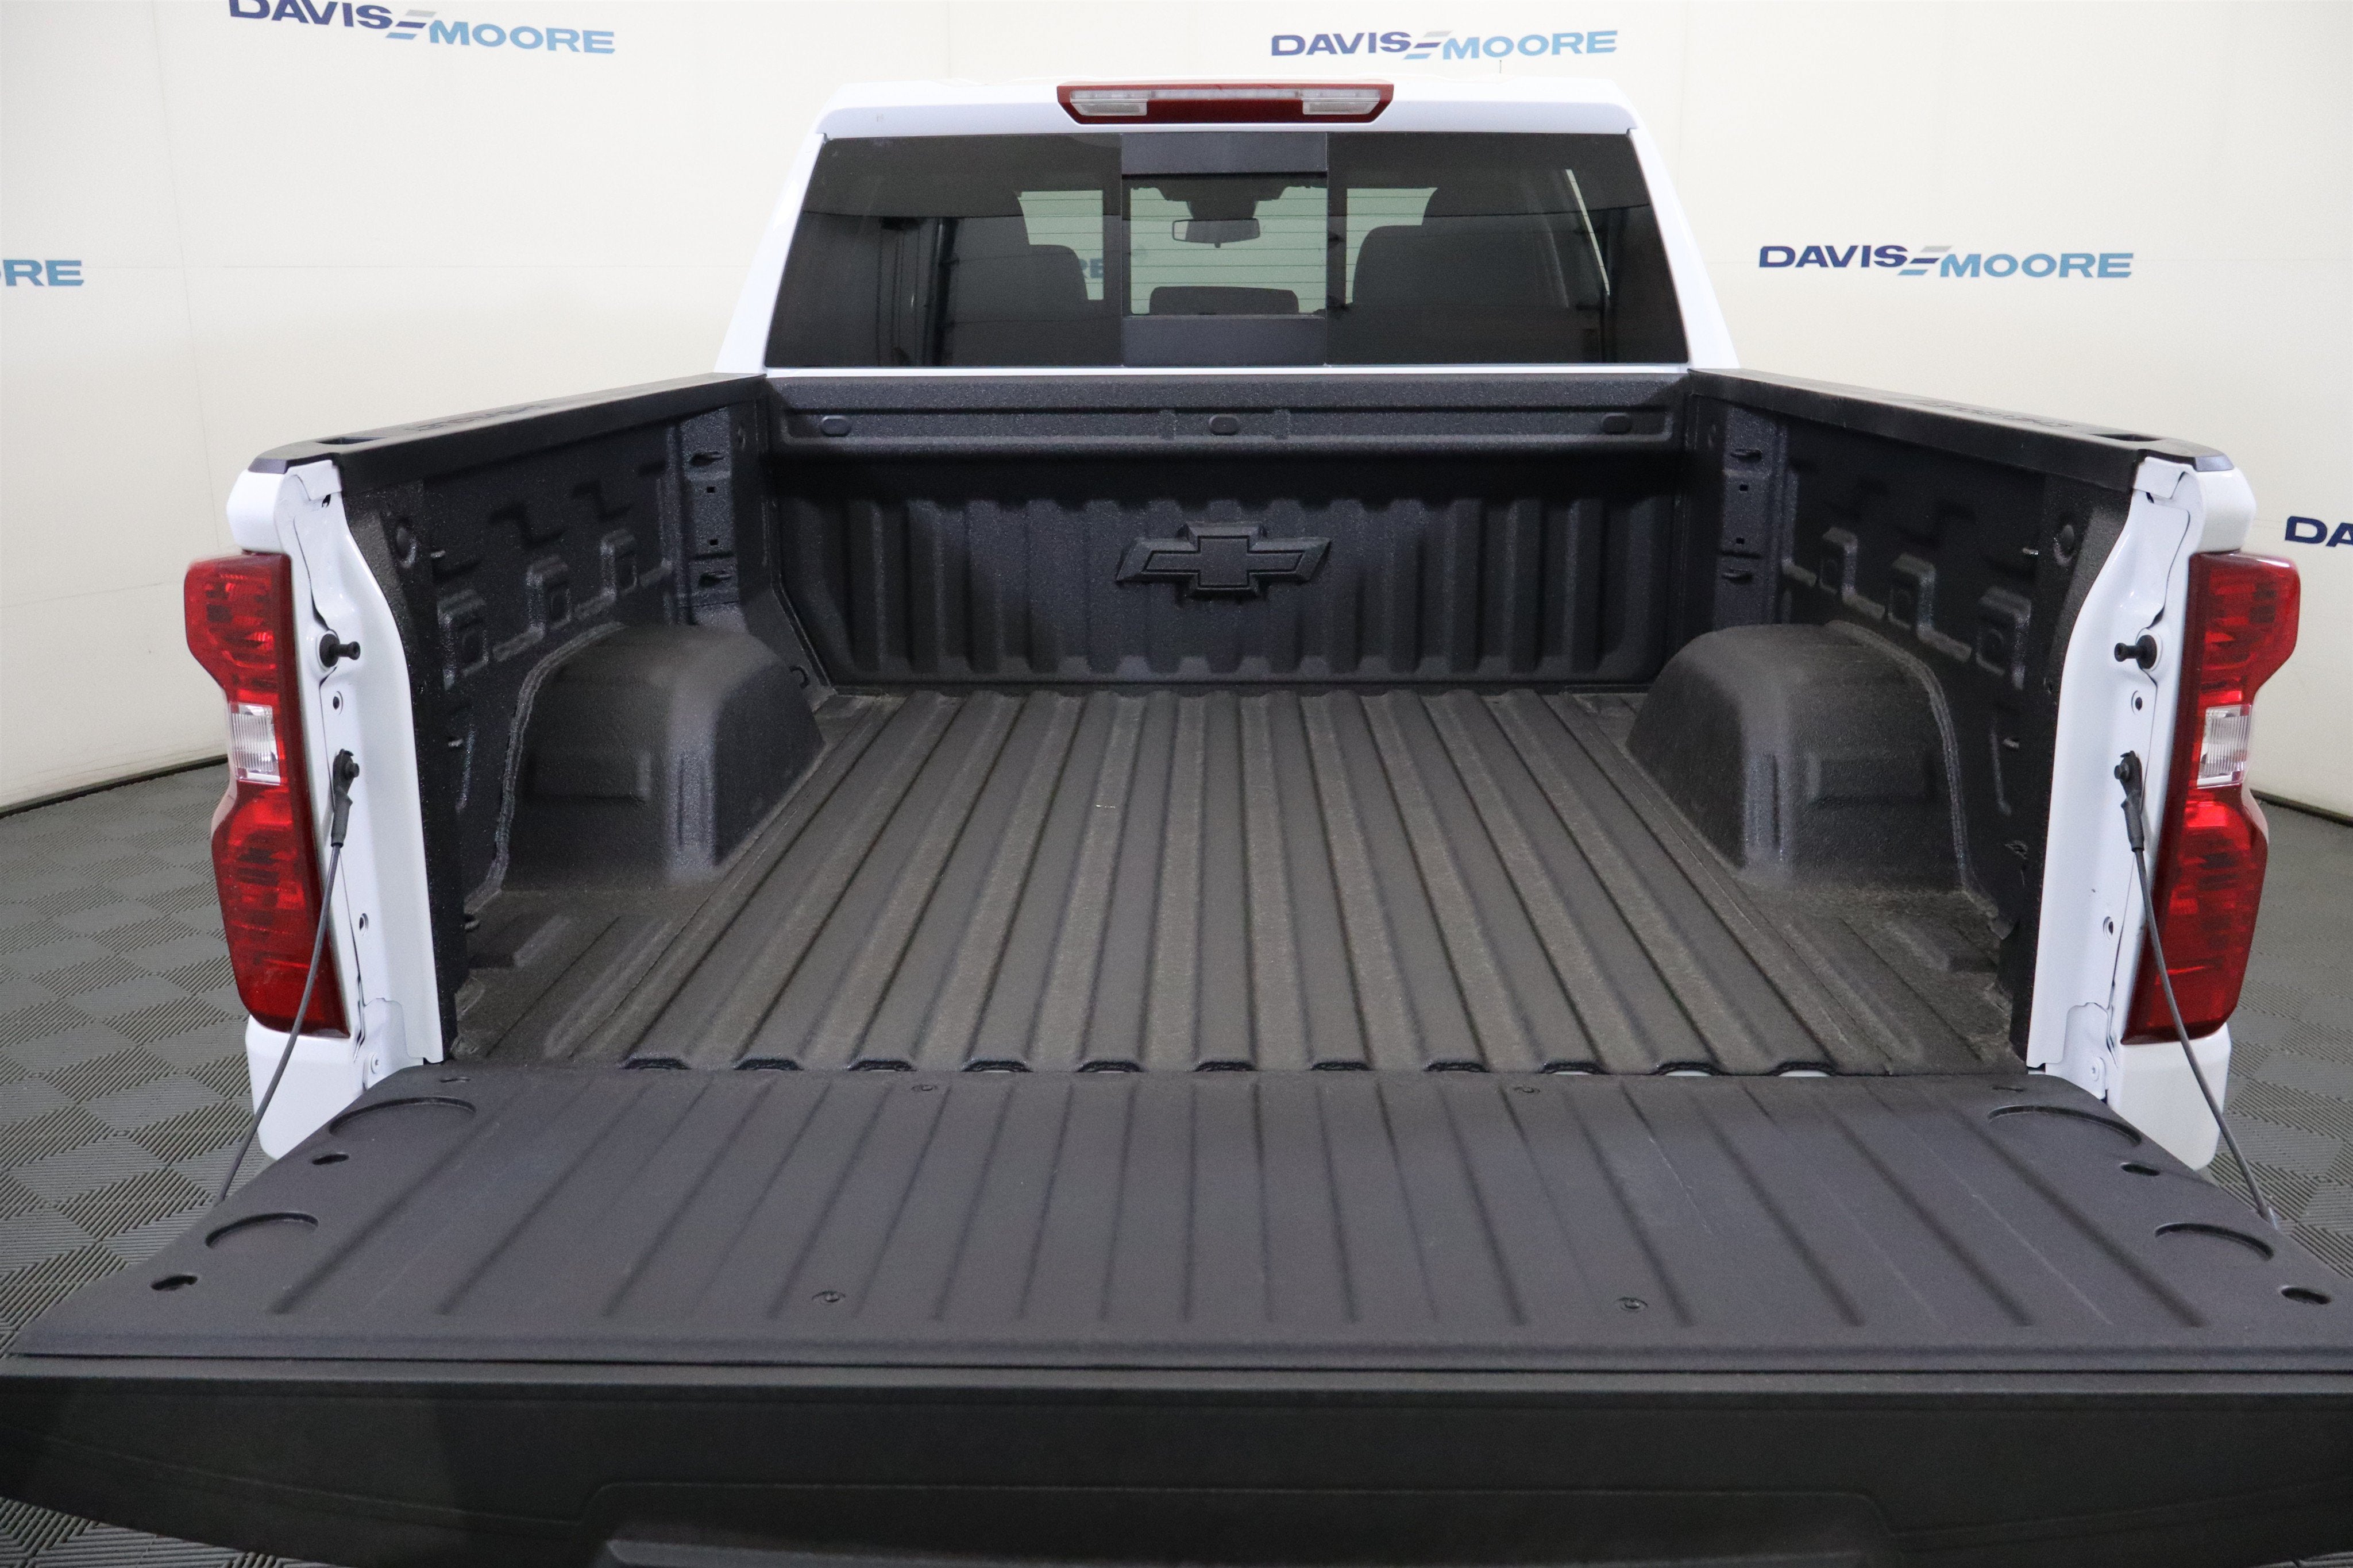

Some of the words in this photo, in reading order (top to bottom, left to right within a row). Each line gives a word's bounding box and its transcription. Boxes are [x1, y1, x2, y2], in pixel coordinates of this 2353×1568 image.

[228, 0, 394, 29] DAVIS
[429, 20, 615, 54] MOORE
[1271, 31, 1412, 56] DAVIS
[1443, 30, 1618, 60] MOORE
[0, 258, 84, 287] RE
[1758, 245, 1909, 268] DAVIS
[1940, 253, 2134, 279] MOORE
